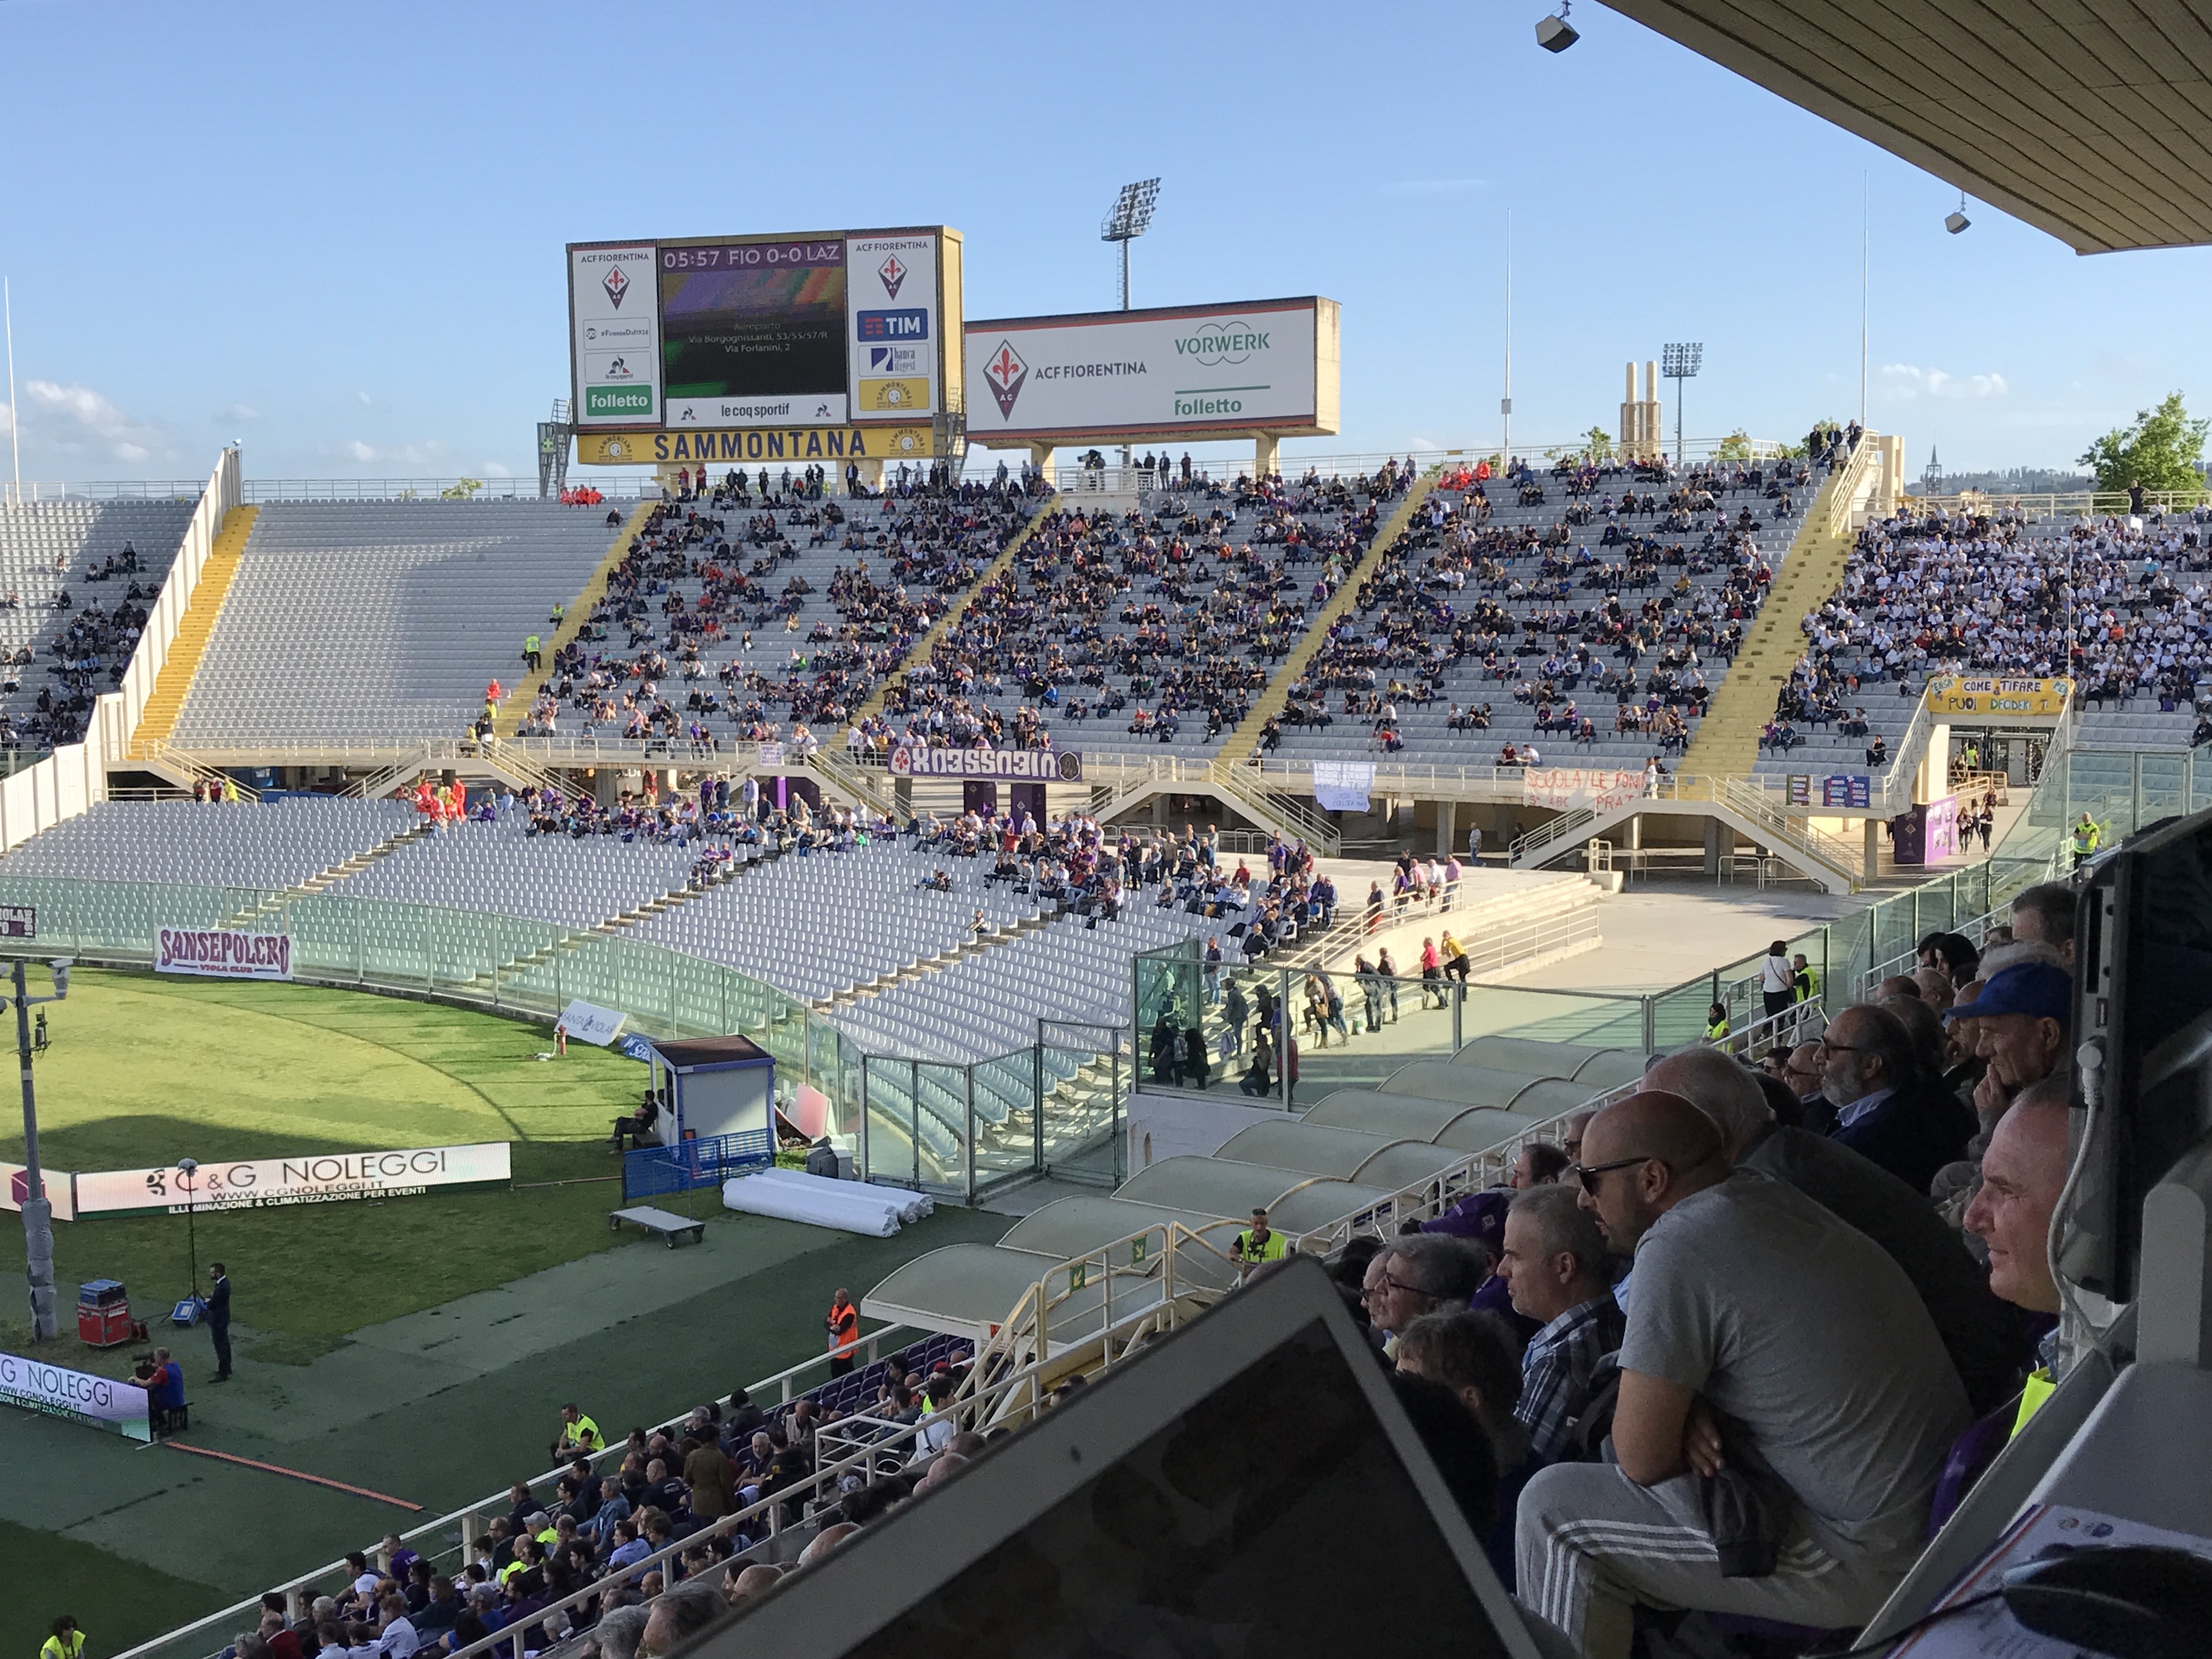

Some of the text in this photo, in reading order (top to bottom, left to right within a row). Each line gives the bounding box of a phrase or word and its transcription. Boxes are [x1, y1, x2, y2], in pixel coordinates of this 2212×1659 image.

[664, 245, 839, 268] 05:57 FIO 0-0 LAZ
[855, 241, 928, 252] ACF FIORENTINA
[599, 253, 649, 262] FIORENTINA
[886, 316, 921, 335] TIM
[1174, 332, 1270, 355] VORWERK
[1035, 361, 1147, 380] ACF FIORENTINA
[591, 394, 648, 408] folletto
[877, 381, 913, 401] SAMMONTANA
[721, 403, 790, 418] le coq sportif
[1174, 399, 1243, 416] folletto
[654, 430, 866, 460] SAMMONTANA
[1931, 679, 1953, 691] ENSA
[1963, 680, 1992, 691] COME
[1999, 680, 2041, 692] TIFARE
[912, 748, 1056, 778] VIEUSSEUX
[1527, 770, 1582, 789] SCUOLA
[1591, 771, 1607, 789] LE
[161, 929, 290, 974] SANSEPOLCRO
[283, 1150, 445, 1184] NOLEGGI
[211, 1180, 385, 1201] WWW.CGNOLEGGI.IT
[266, 1191, 361, 1206] CLIMATIZZAZIONE
[364, 1189, 386, 1199] PER
[388, 1186, 426, 1197] EVENTI
[28, 1364, 113, 1408] NOLEGGI
